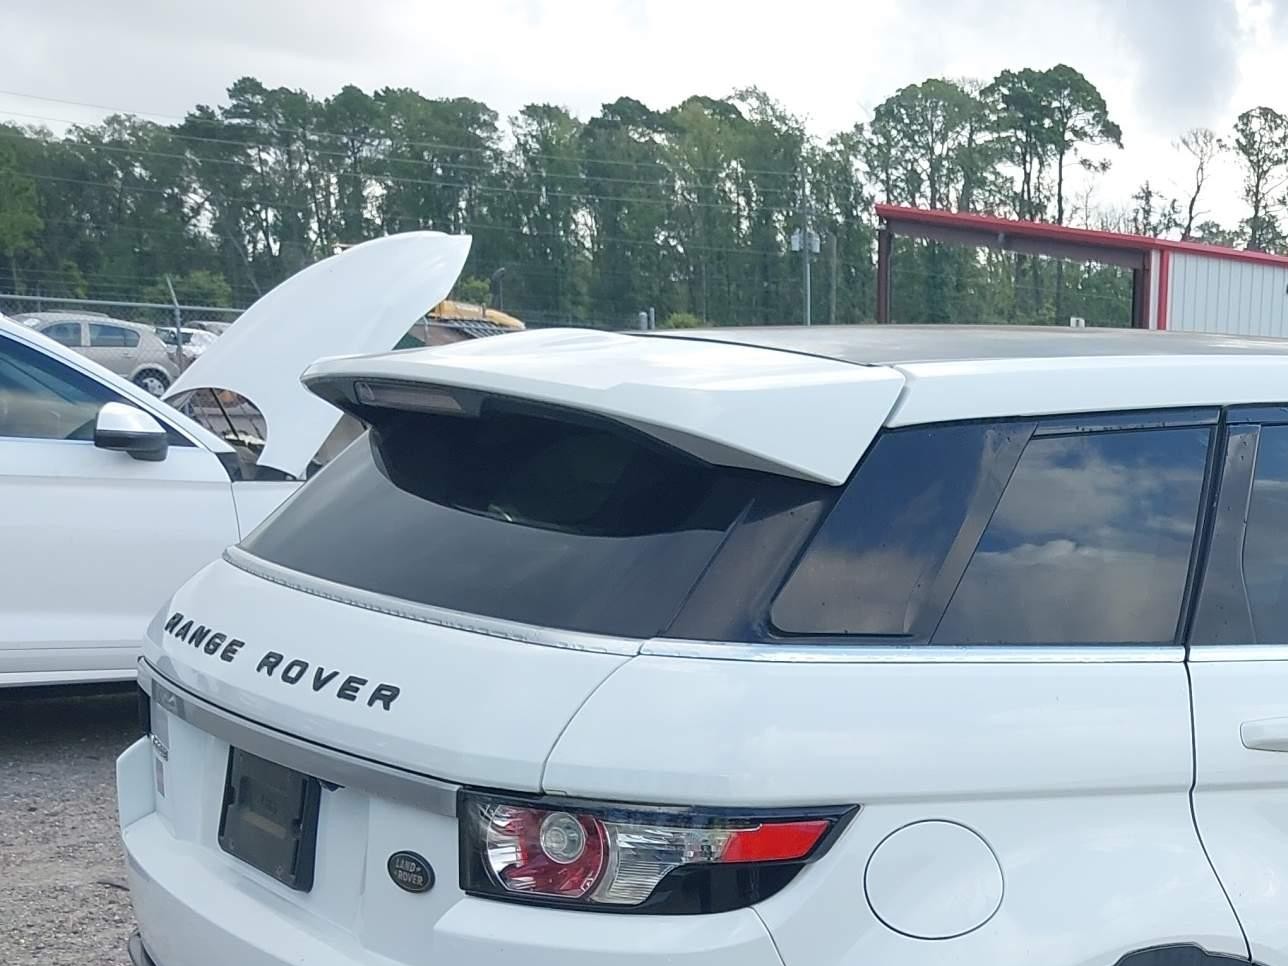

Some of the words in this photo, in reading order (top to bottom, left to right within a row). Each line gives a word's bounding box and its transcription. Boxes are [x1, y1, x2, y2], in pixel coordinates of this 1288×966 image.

[163, 612, 246, 662] RANGE
[256, 651, 401, 711] ROVER
[396, 858, 417, 872] LAND
[399, 870, 424, 886] ROVER
